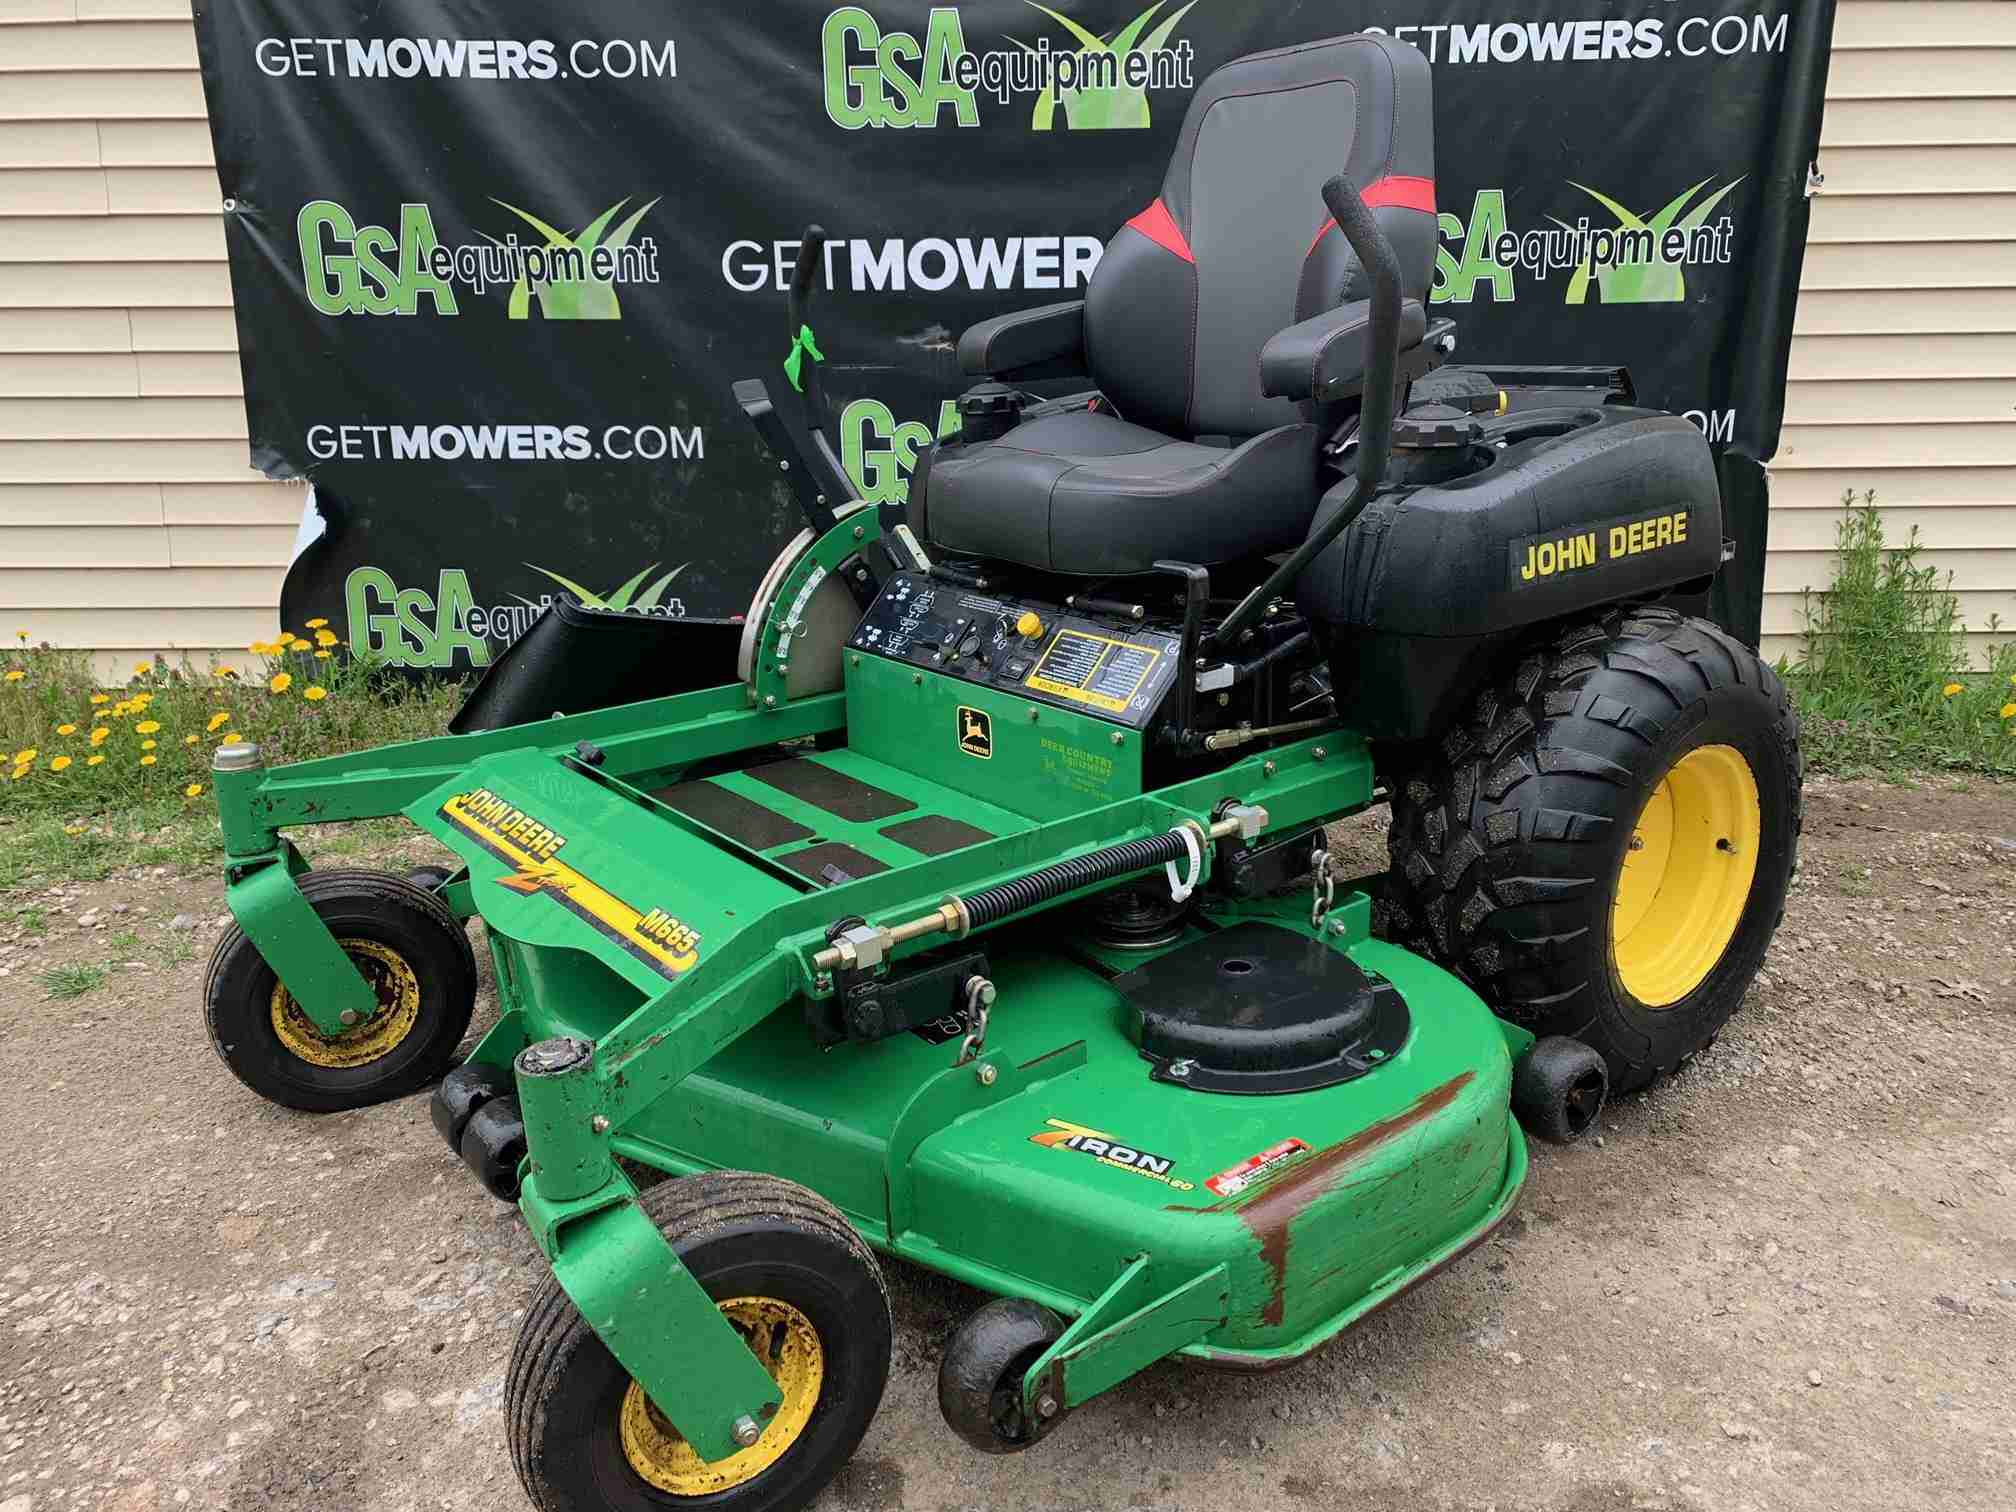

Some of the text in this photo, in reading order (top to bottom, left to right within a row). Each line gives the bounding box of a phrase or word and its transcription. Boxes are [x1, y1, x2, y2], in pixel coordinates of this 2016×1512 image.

[255, 38, 678, 79] GETMOWERS.COM
[1362, 14, 1788, 63] TMOWERS.COM
[721, 236, 1104, 292] GETMOWER
[306, 424, 705, 460] GETMOWERS.COM
[1521, 511, 1687, 580] JOHN DEERE
[457, 788, 568, 863] JOHN DEERE
[638, 908, 700, 953] M665
